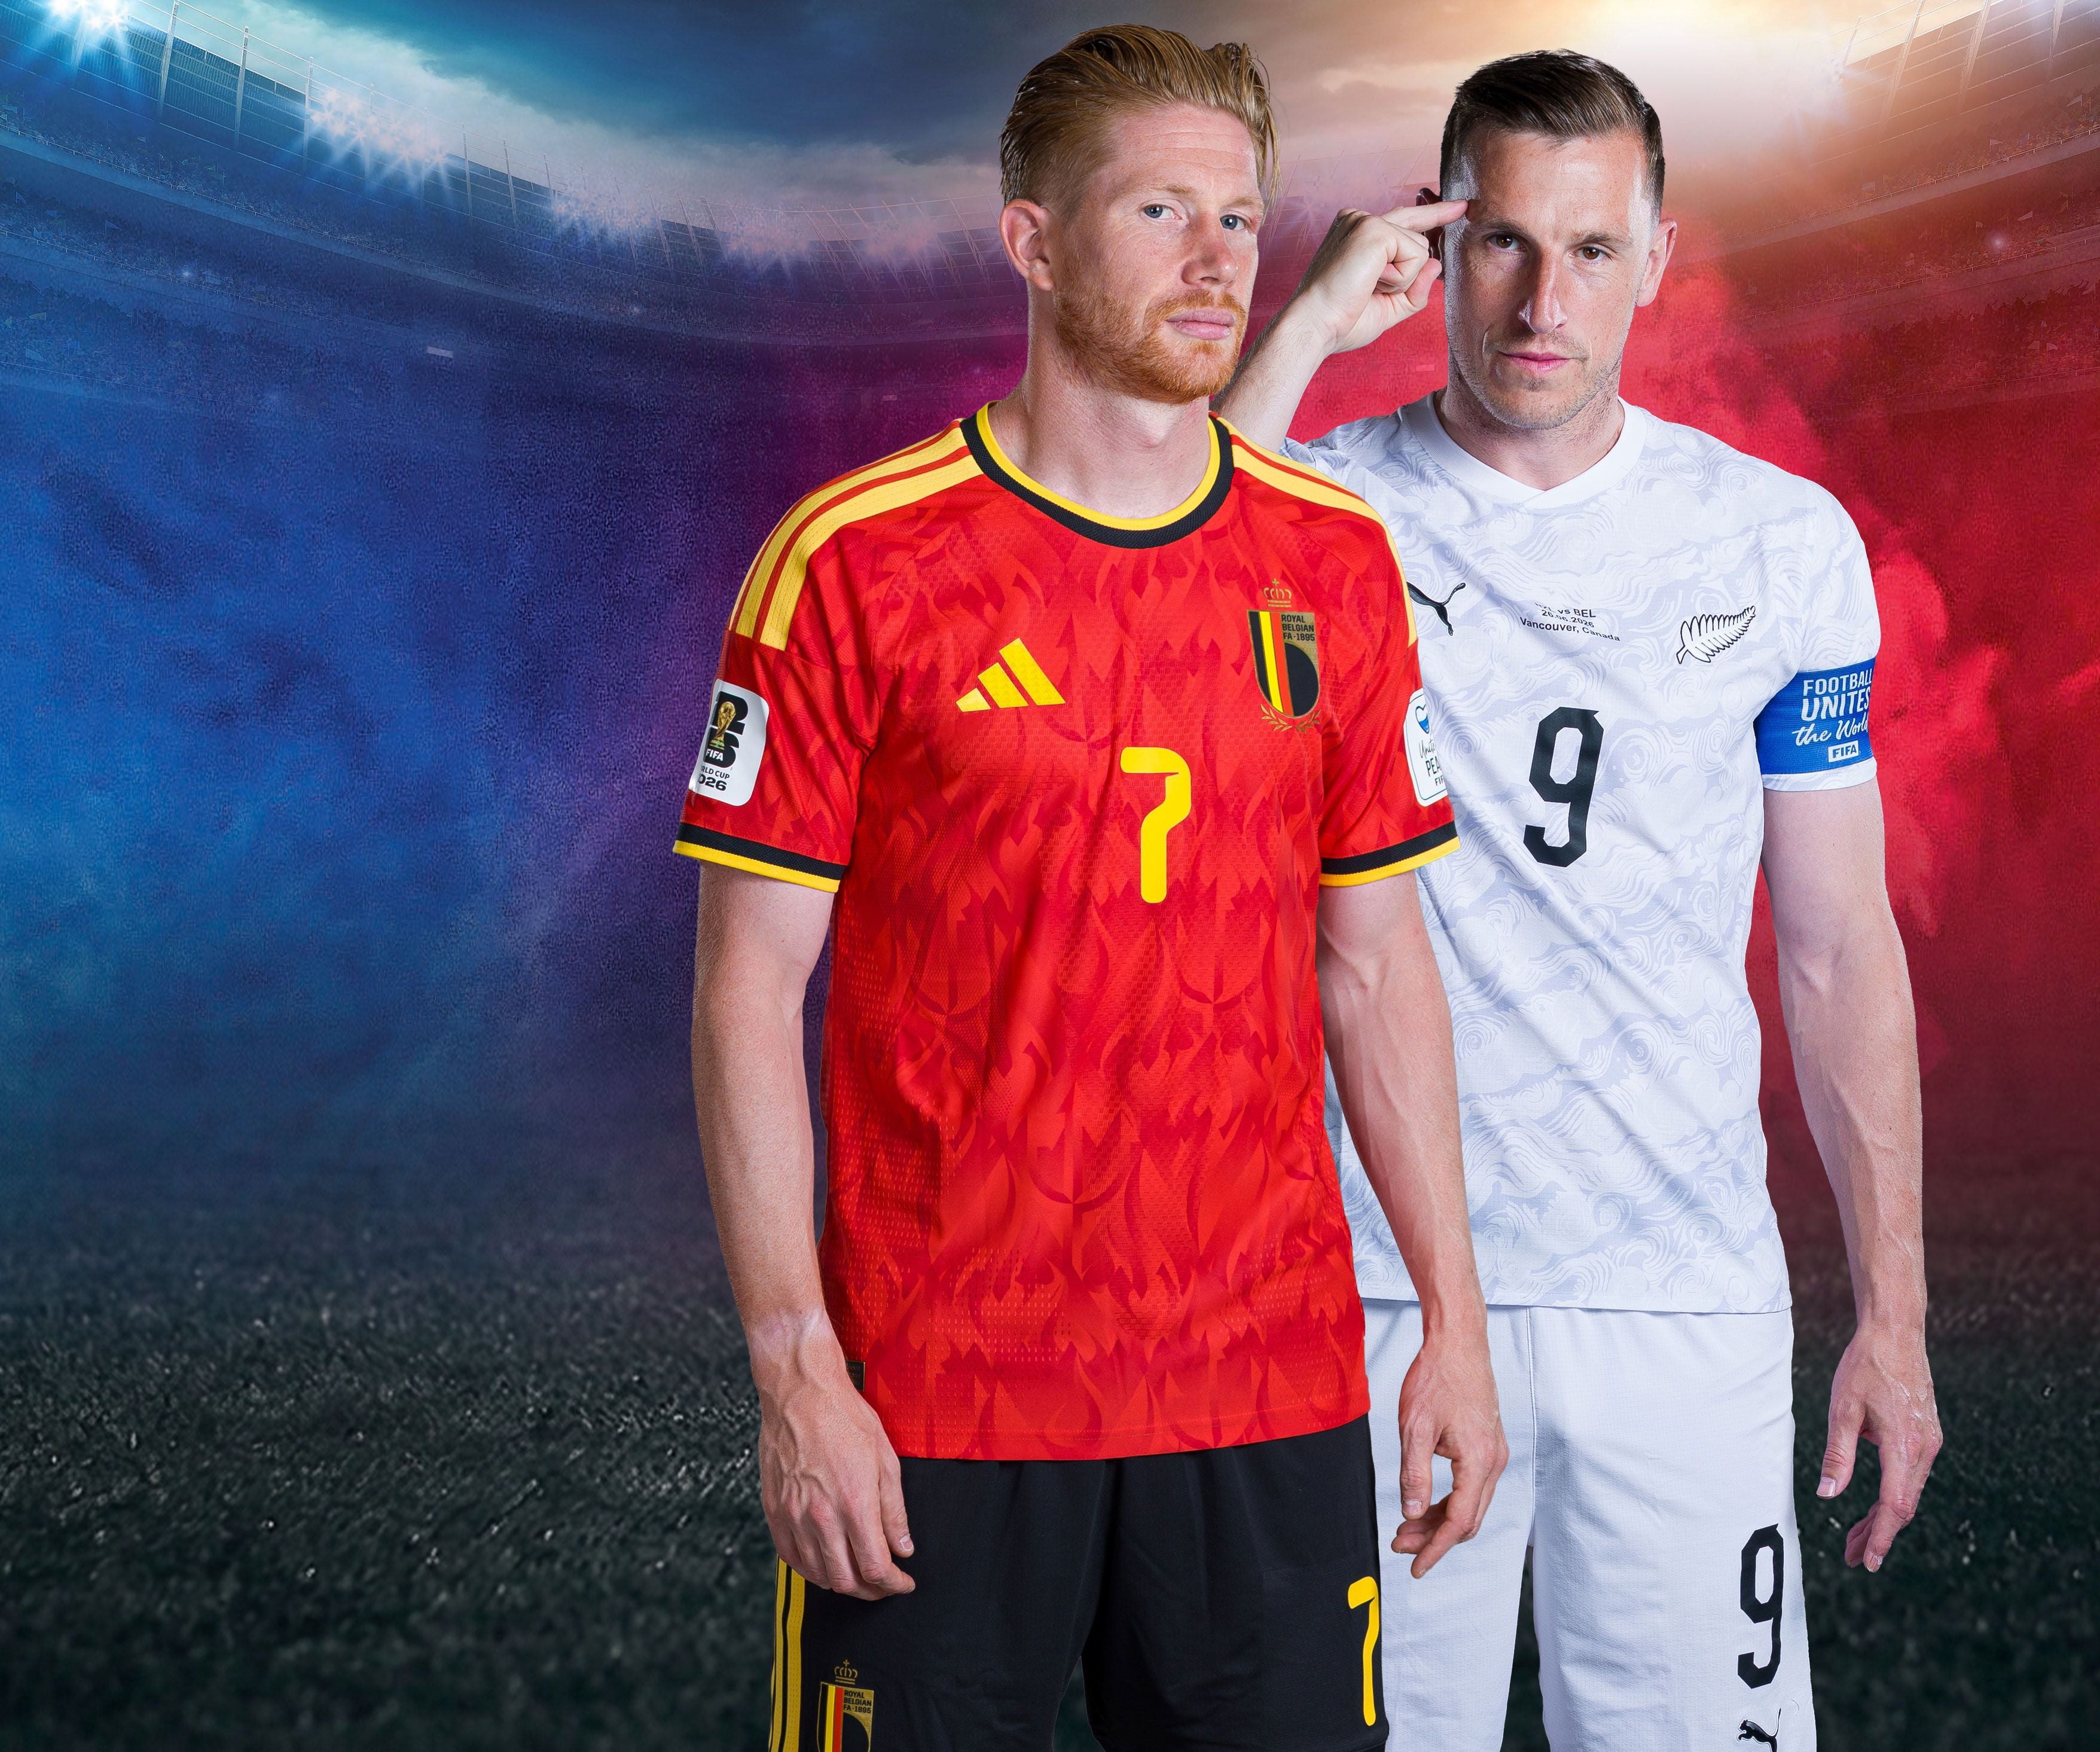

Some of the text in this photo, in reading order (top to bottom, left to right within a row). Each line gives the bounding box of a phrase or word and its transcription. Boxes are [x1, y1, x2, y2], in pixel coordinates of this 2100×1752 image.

[1281, 614, 1305, 623] ROYAL
[1573, 609, 1597, 618] BEL
[1282, 623, 1314, 632] BELGIAN
[1519, 616, 1621, 642] Vancouver, Canada
[1802, 668, 1872, 697] FOOTBALL
[1801, 686, 1871, 722] UNITES
[1791, 712, 1869, 746] the World
[706, 748, 724, 761] FIFA
[1832, 744, 1857, 759] FIFA
[701, 765, 730, 779] RLD CUP
[1425, 756, 1442, 777] PEA
[697, 773, 727, 791] 026
[1434, 775, 1443, 786] FIF
[1523, 707, 1604, 868] 9
[1120, 746, 1192, 904] 7
[1738, 1523, 1784, 1689] 9
[1347, 1576, 1379, 1726] 7
[844, 1690, 865, 1699] ROYAL
[844, 1697, 872, 1707] BELGIAN
